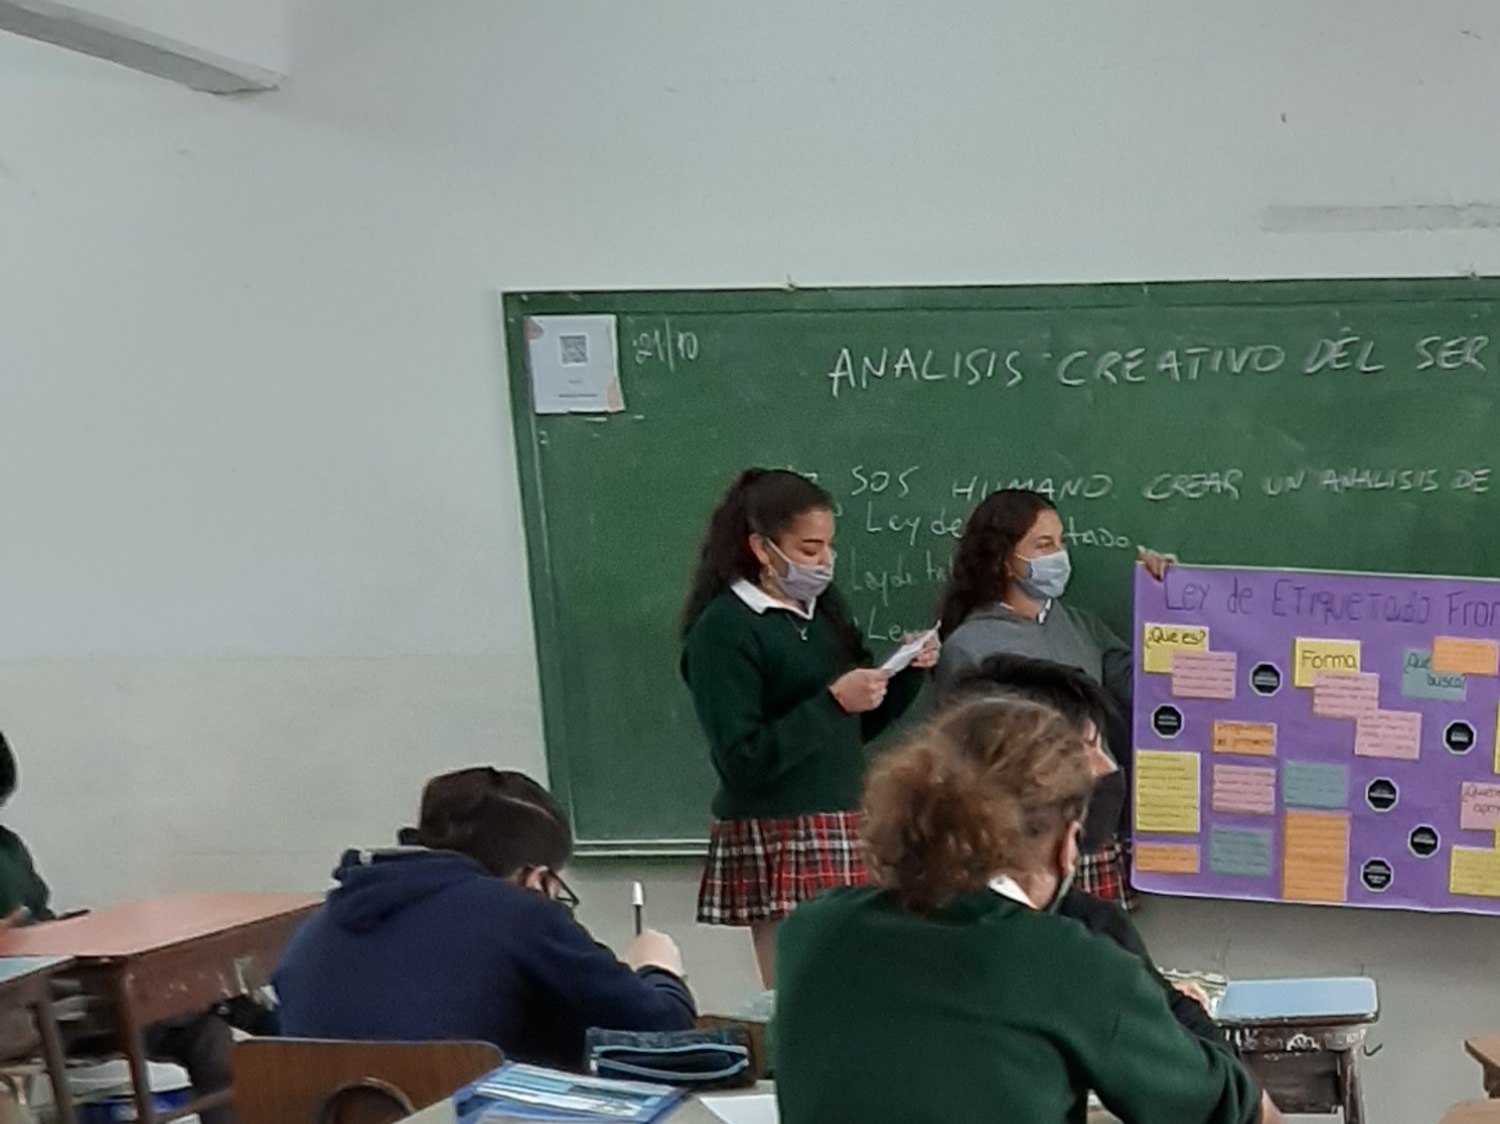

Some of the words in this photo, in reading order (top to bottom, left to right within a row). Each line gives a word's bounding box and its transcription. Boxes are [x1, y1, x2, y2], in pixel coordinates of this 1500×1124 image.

[828, 347, 1024, 397] ANALISIS
[1057, 344, 1286, 387] CREATIVO
[1416, 335, 1490, 371] SER
[851, 465, 920, 498] SOS
[1143, 468, 1244, 499] CREAR
[1264, 470, 1305, 496] UN
[1322, 467, 1439, 493] ANALISIS
[1452, 468, 1491, 492] DE
[1164, 572, 1211, 612] Ley
[1227, 576, 1254, 614] de
[1300, 649, 1358, 670] Forma
